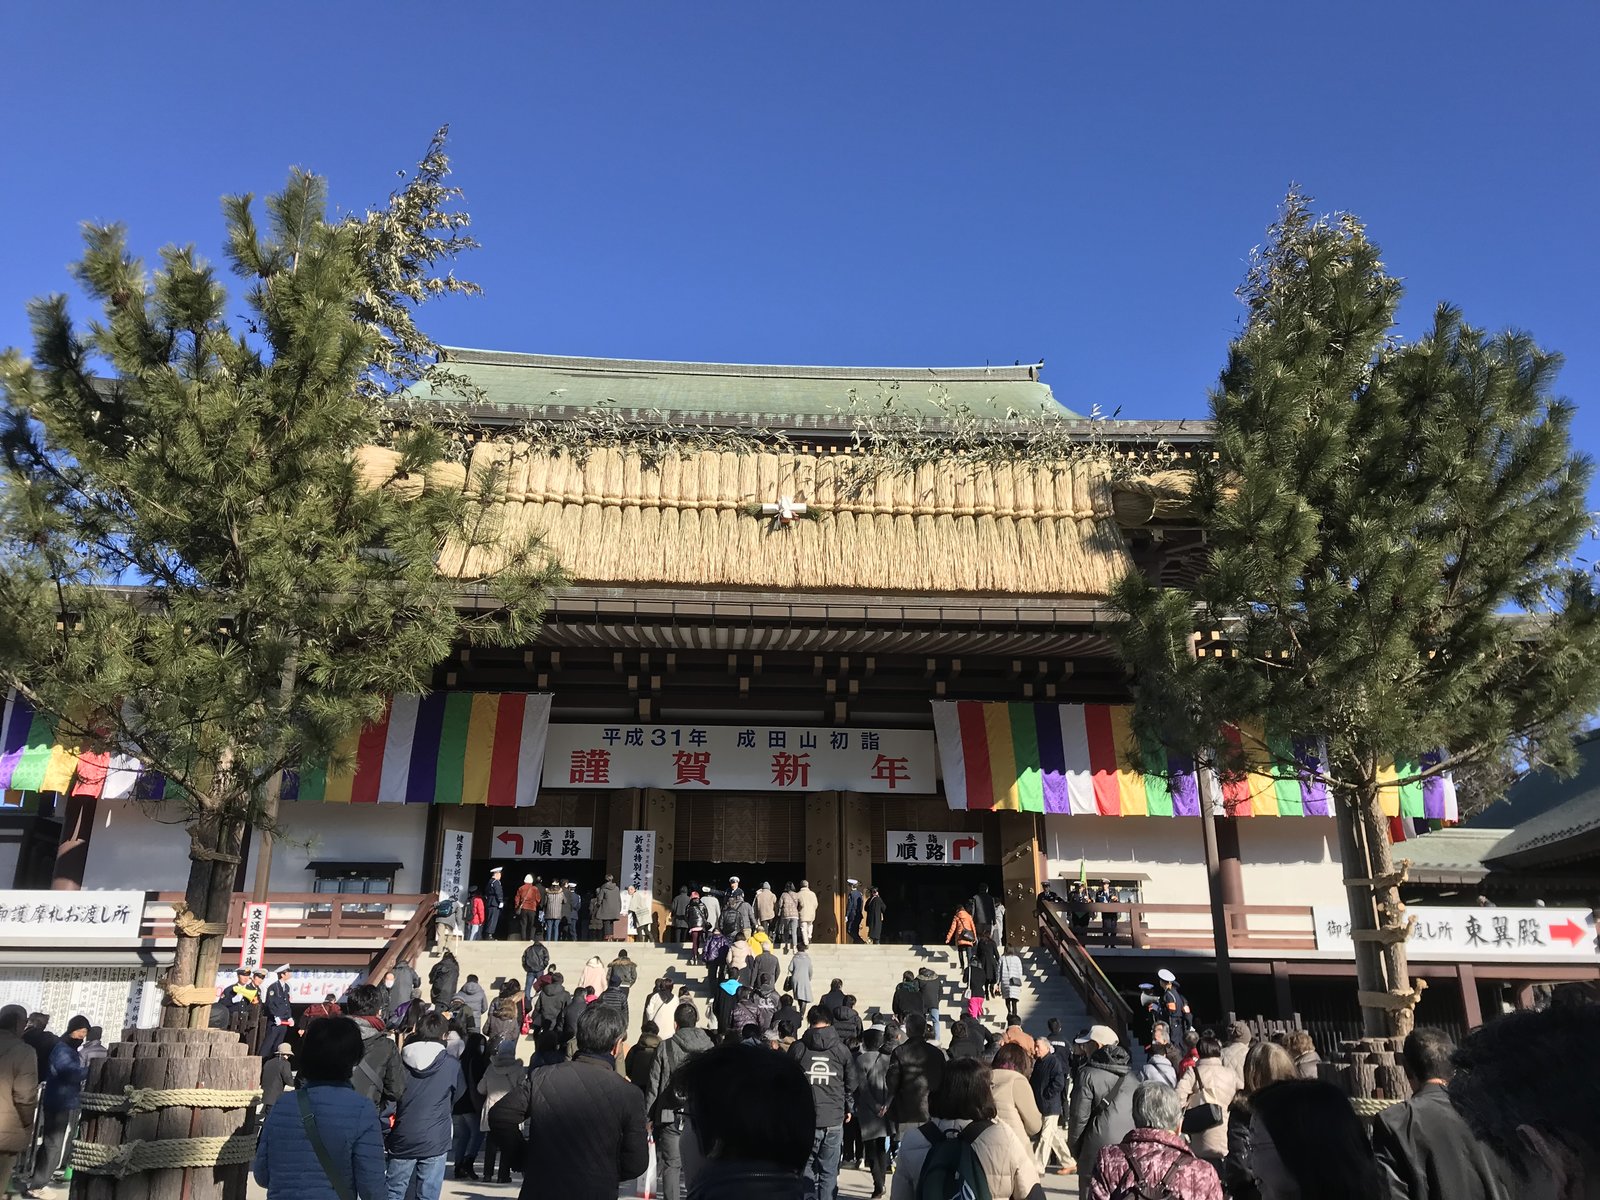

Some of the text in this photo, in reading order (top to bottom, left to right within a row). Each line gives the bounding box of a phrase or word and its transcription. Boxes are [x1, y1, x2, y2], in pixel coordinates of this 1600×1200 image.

[602, 727, 881, 751] 平成31年 成田山初詣
[569, 749, 912, 789] 謹賀新年
[532, 839, 582, 857] 順路
[896, 843, 946, 861] 順路
[1464, 914, 1547, 949] 東翼殿
